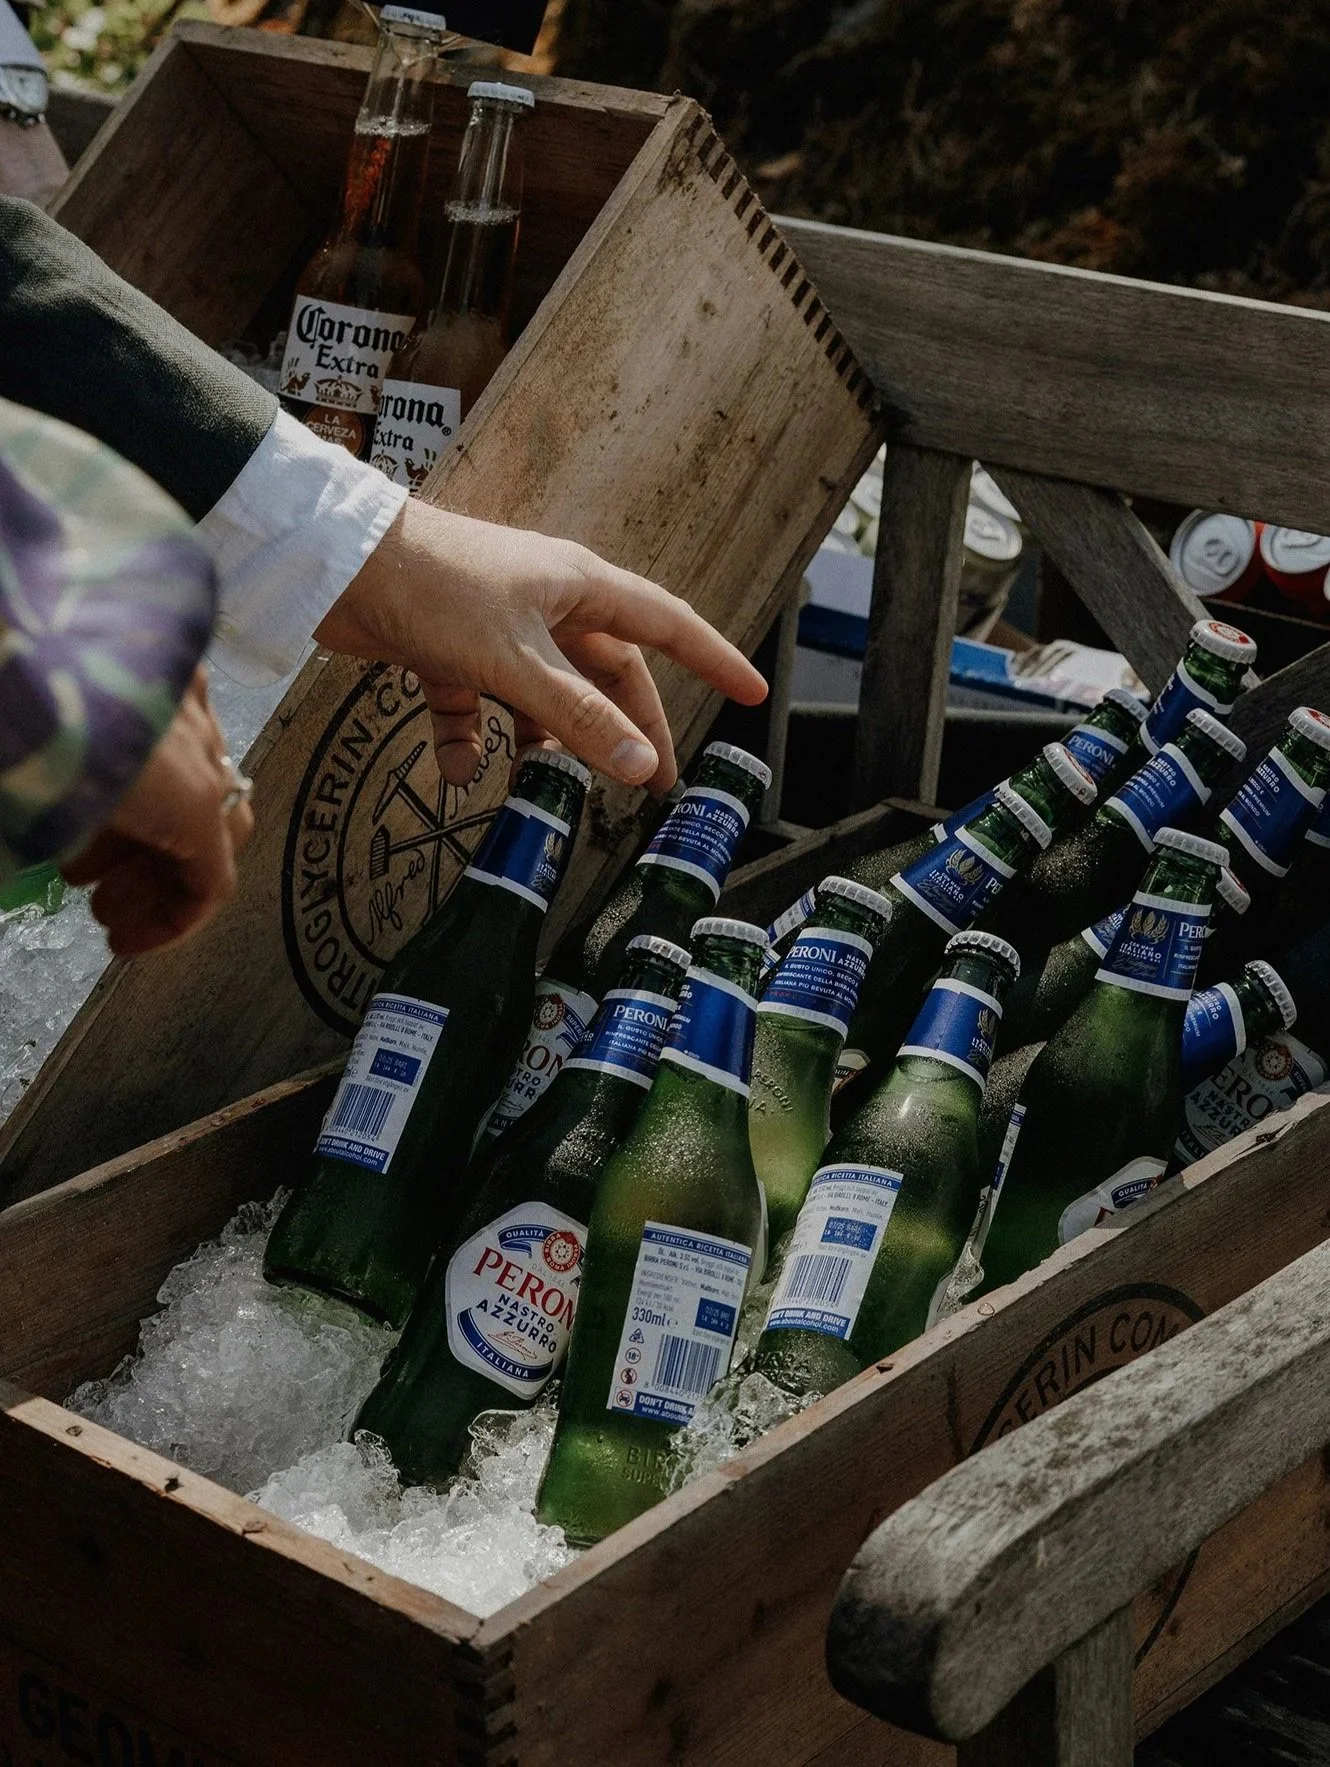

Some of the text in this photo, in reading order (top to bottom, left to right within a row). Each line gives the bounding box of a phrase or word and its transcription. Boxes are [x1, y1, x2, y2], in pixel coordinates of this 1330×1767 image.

[296, 304, 405, 352] Corona
[315, 343, 379, 379] Extra
[325, 413, 340, 425] LA
[306, 421, 357, 440] CERVEZA
[1068, 735, 1115, 766] PERONI
[705, 811, 739, 838] AZZURRO
[715, 808, 739, 828] NASTRO
[681, 827, 700, 837] DELLA
[703, 825, 724, 840] SECCO
[678, 835, 701, 847] BEVUTA
[703, 843, 710, 851] AL
[929, 869, 964, 900] ITALIANO
[785, 945, 837, 964] PERONI
[1120, 942, 1162, 960] ITALIANO
[790, 962, 811, 971] GUSTO
[836, 972, 856, 985] SECCO
[810, 984, 835, 996] BEVUTA
[813, 975, 833, 986] DELLA
[833, 980, 850, 992] BIRRA
[407, 1005, 439, 1022] ITALIANA
[613, 1004, 668, 1031] PERONI
[625, 1025, 648, 1036] GUSTO
[608, 1039, 637, 1051] ITALIANA
[348, 1142, 363, 1153] AND
[363, 1147, 386, 1161] DRIVE
[858, 1173, 893, 1187] ITALIANA
[650, 1232, 695, 1249] AUTENTICA
[695, 1243, 725, 1256] RICETTA
[498, 1293, 555, 1332] NASTRO
[632, 1306, 666, 1327] 330ml
[805, 1310, 822, 1321] AND
[822, 1314, 846, 1328] DRIVE
[476, 1299, 557, 1354] AZZURRO
[476, 1342, 530, 1379] ITALIANA
[639, 1394, 663, 1408] DON'T
